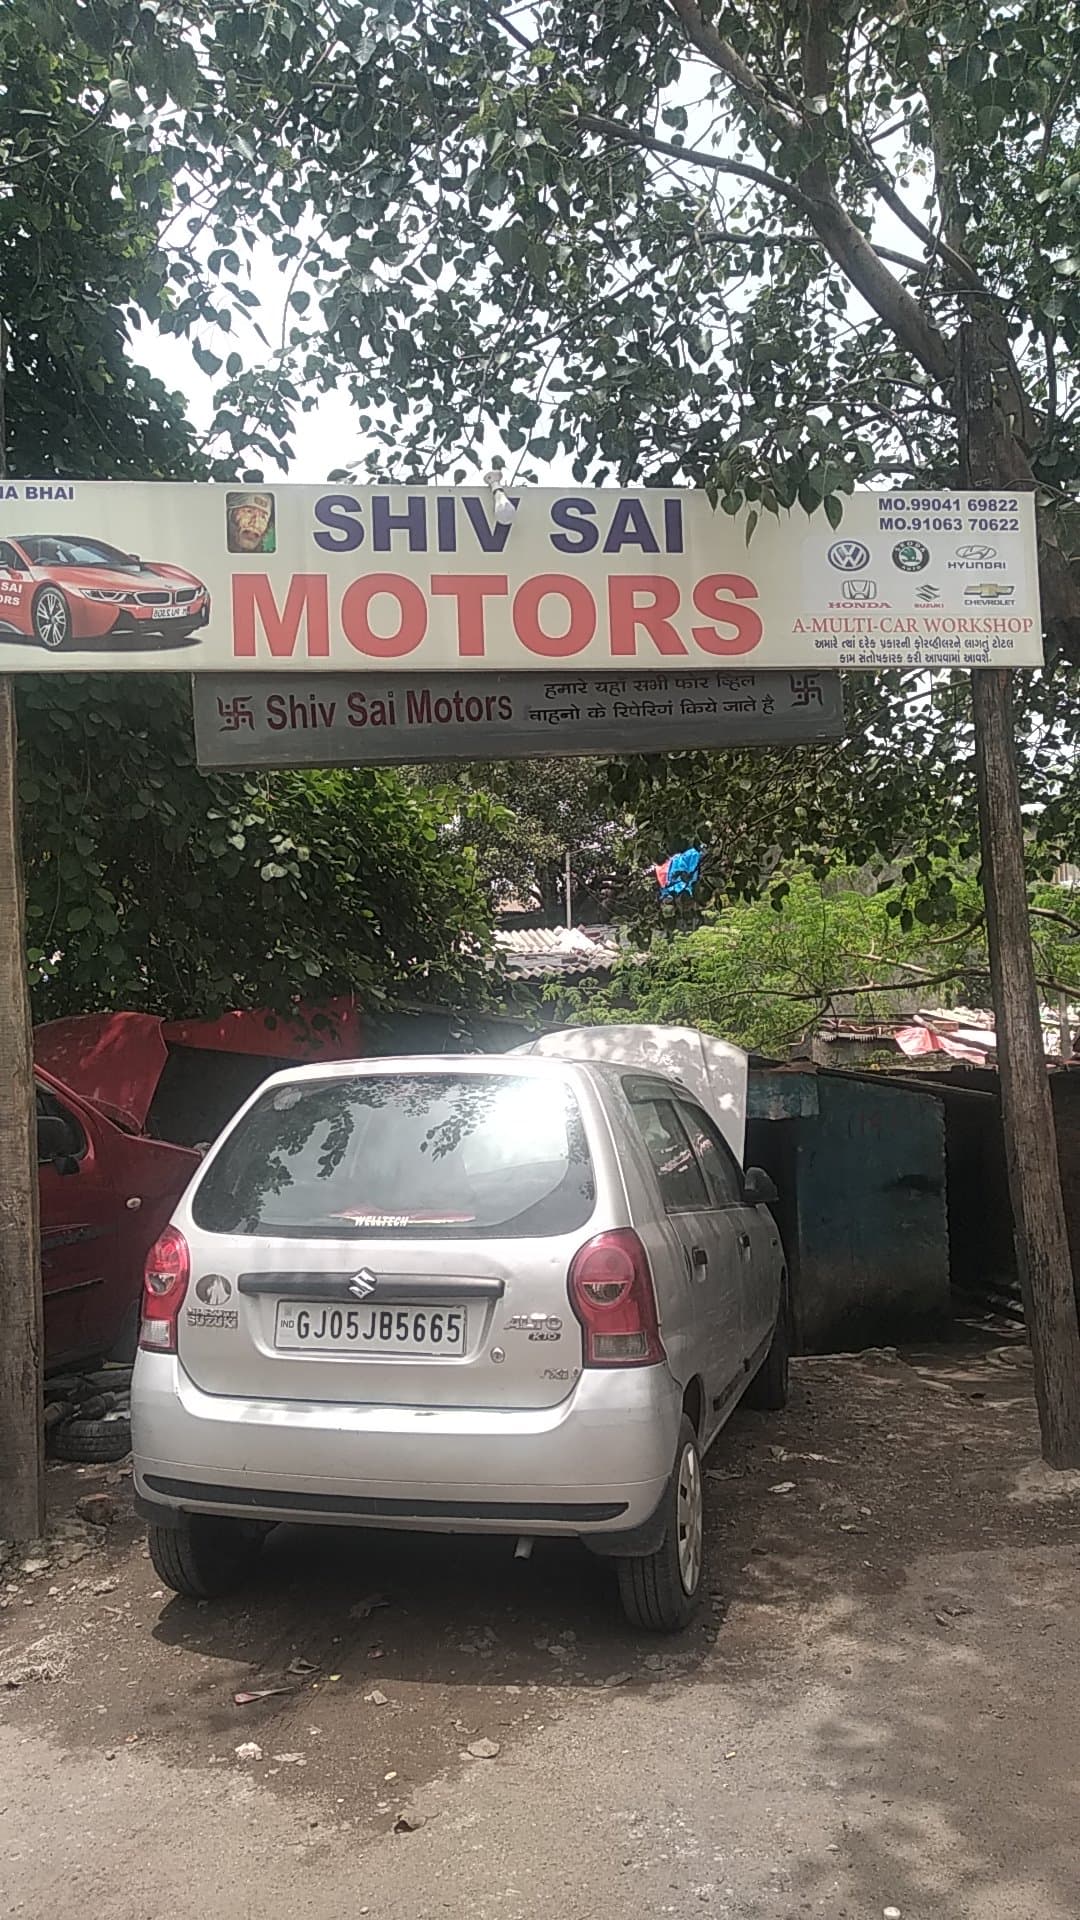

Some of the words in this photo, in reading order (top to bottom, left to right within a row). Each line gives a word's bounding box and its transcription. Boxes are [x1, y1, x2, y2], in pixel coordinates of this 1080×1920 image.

[26, 487, 74, 500] BHAI
[878, 498, 962, 512] MO.99041
[967, 498, 1019, 512] 69822
[313, 494, 520, 552] SHIV
[550, 497, 685, 554] SAI
[879, 517, 963, 531] MO.91063
[968, 517, 1020, 531] 70622
[947, 561, 1006, 570] HYUNDAI
[1, 581, 23, 593] SAI
[230, 572, 764, 658] MOTORS
[791, 617, 919, 634] A-MULTI-CAR
[924, 617, 1034, 633] WORKSHOP
[814, 635, 838, 649] અમારે
[859, 635, 877, 649] દરેક
[840, 652, 856, 664] કામ
[543, 678, 589, 700] हमारे
[632, 674, 669, 692] सभी
[266, 692, 337, 731] Shiv
[347, 690, 396, 728] Sai
[406, 689, 513, 725] Motors
[586, 702, 607, 719] के
[680, 697, 718, 715] किये
[722, 695, 757, 713] जाते
[354, 1216, 410, 1227] WELLTECH
[187, 1315, 239, 1329] SUZUKI
[280, 1319, 295, 1329] IND
[296, 1309, 462, 1344] GJ05JB5665
[503, 1313, 563, 1331] ALTO
